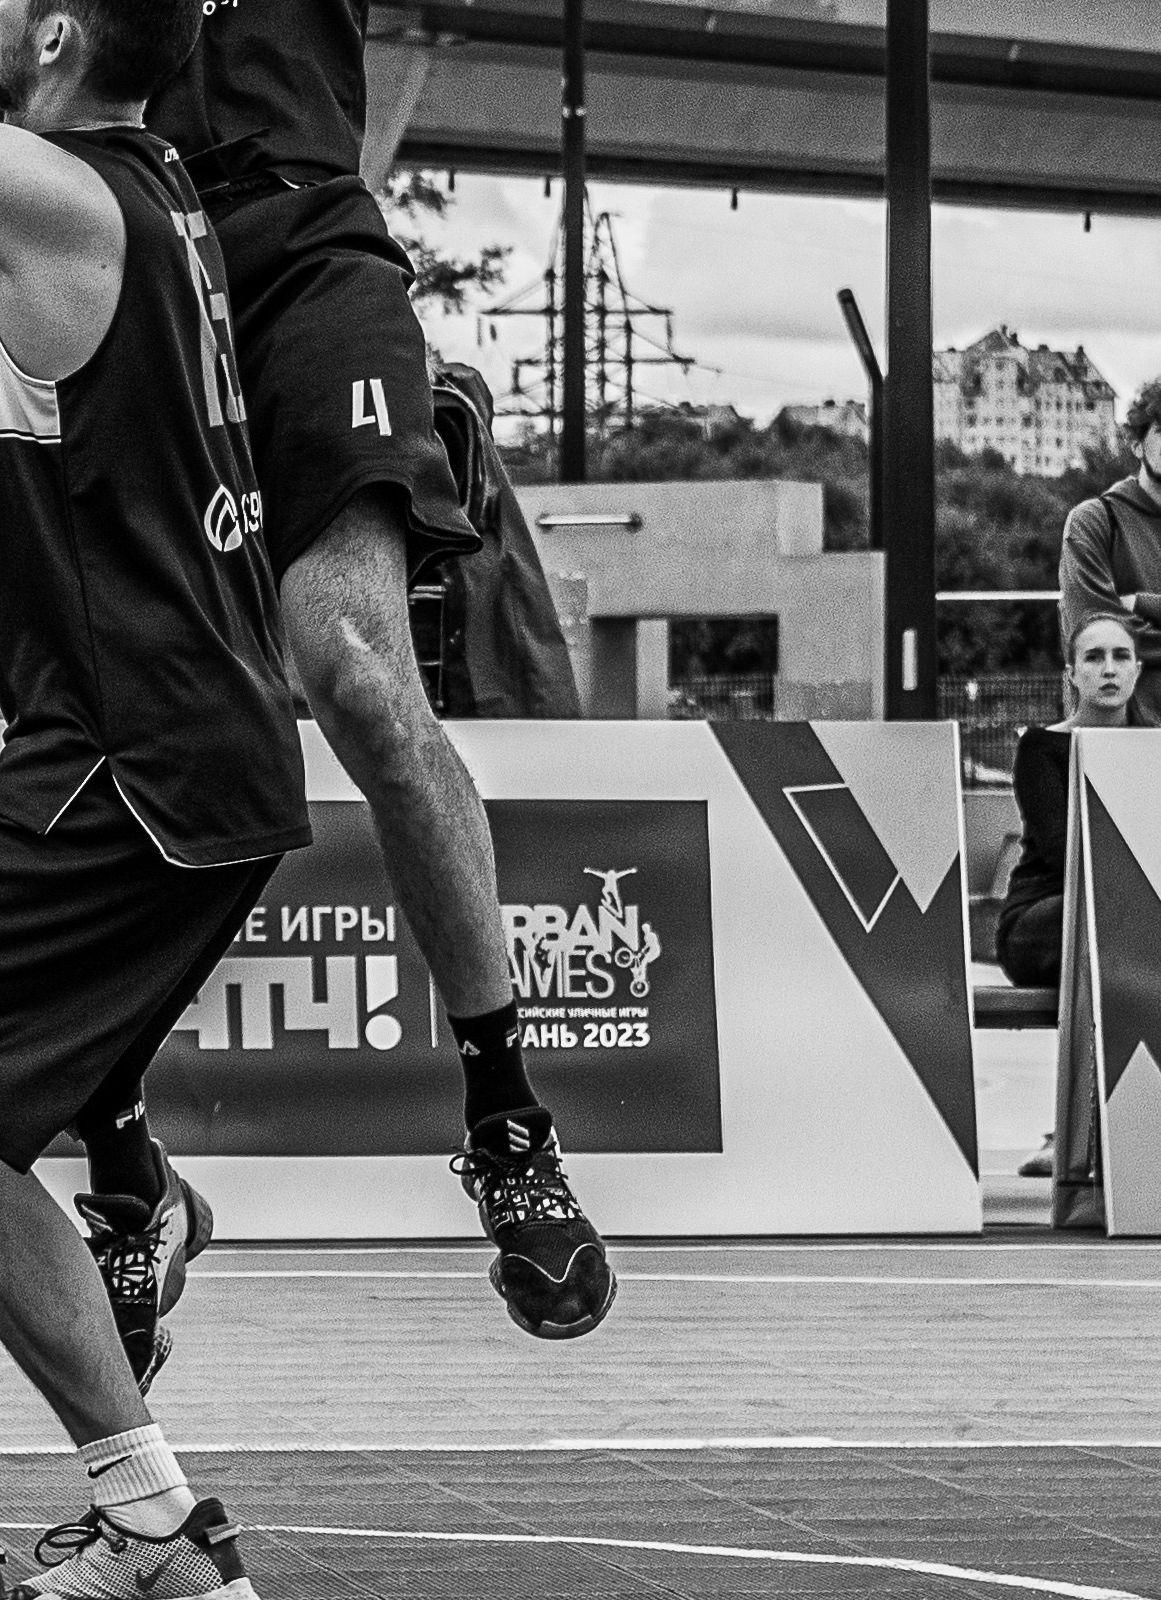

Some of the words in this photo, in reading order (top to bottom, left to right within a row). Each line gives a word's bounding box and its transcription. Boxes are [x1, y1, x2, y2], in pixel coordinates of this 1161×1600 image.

[352, 378, 392, 437] 4
[281, 906, 395, 942] ИГРЫ
[500, 904, 639, 951] RBAN
[517, 1006, 566, 1018] СИЙСКИЕ
[618, 1006, 649, 1018] ИГРЫ
[520, 1023, 578, 1048] АНЬ
[583, 1022, 650, 1048] 2023
